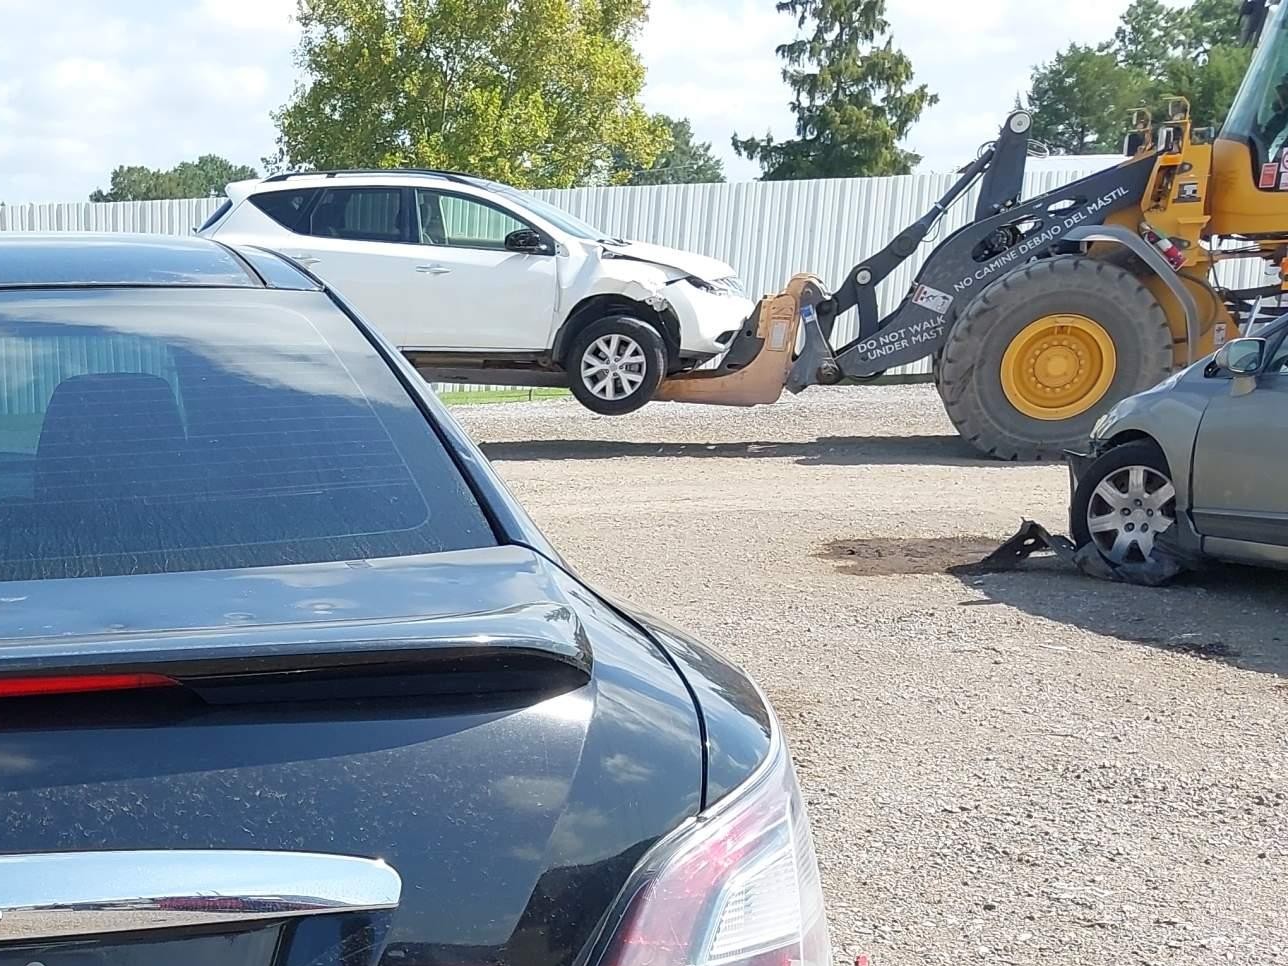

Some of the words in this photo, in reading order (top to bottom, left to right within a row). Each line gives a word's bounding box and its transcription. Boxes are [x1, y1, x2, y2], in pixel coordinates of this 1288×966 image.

[953, 277, 973, 293] NO
[974, 250, 1018, 281] CAMINE
[1019, 225, 1062, 255] DEBAJO
[1063, 211, 1087, 229] DEL
[1087, 186, 1129, 215] MÁSTIL
[857, 339, 877, 353] DO
[879, 328, 906, 346] NOT
[908, 314, 946, 335] WALK
[867, 339, 910, 360] UNDER
[911, 326, 944, 345] MAST
